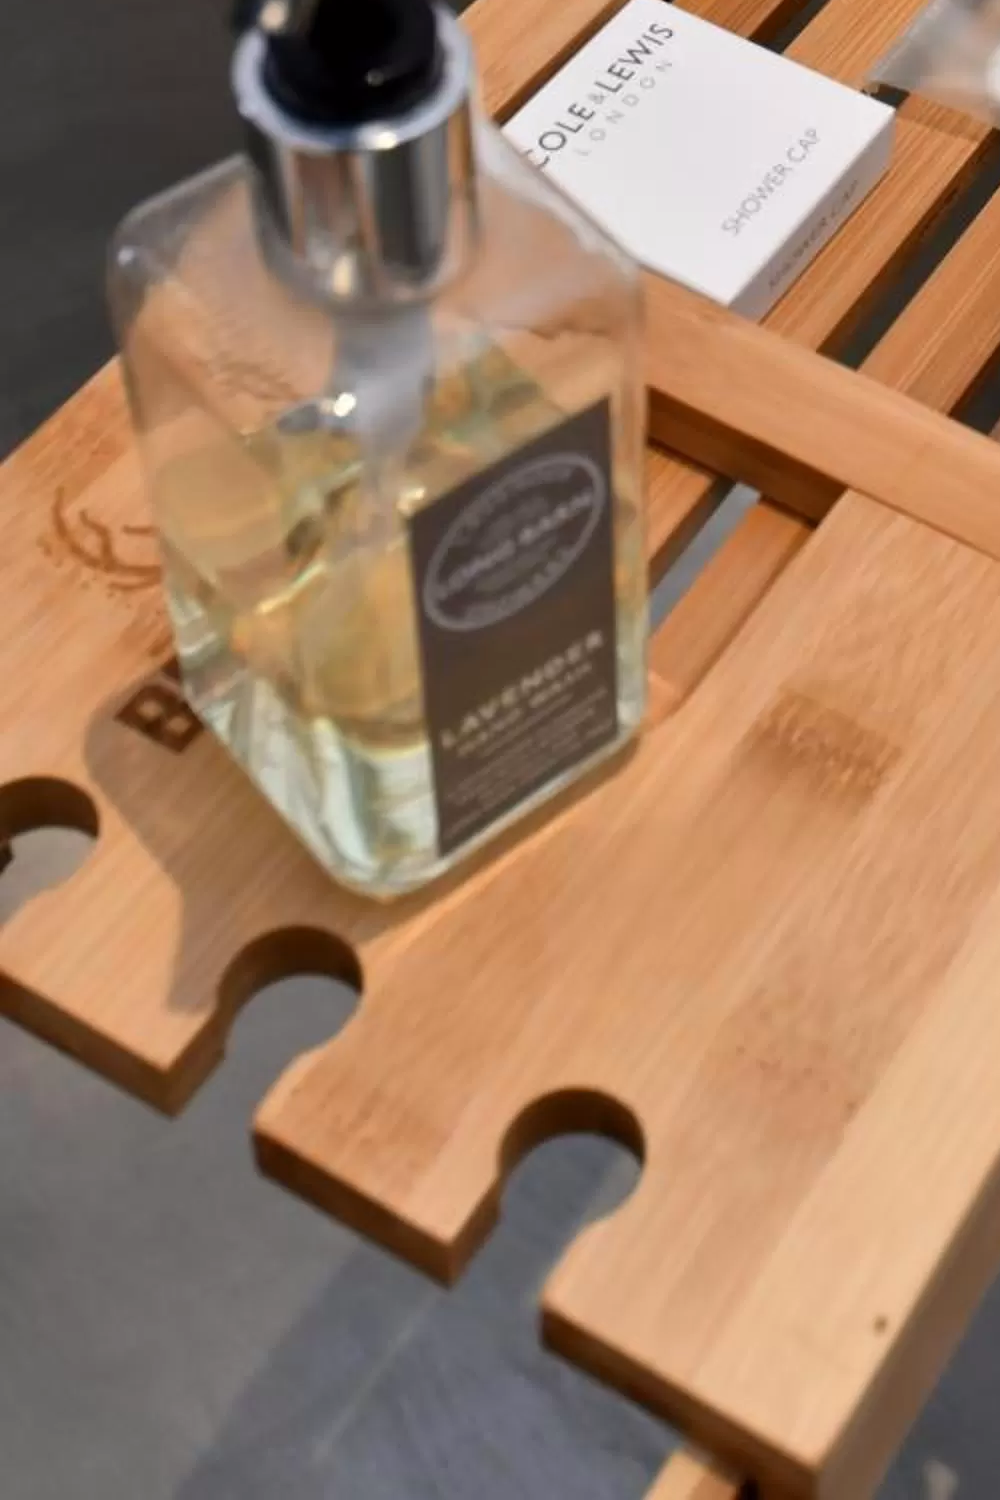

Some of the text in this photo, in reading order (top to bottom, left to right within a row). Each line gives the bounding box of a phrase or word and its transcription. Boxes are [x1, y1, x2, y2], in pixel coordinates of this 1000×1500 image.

[594, 23, 674, 93] LEWIS
[721, 163, 794, 236] SHOWER
[786, 127, 821, 162] CAP
